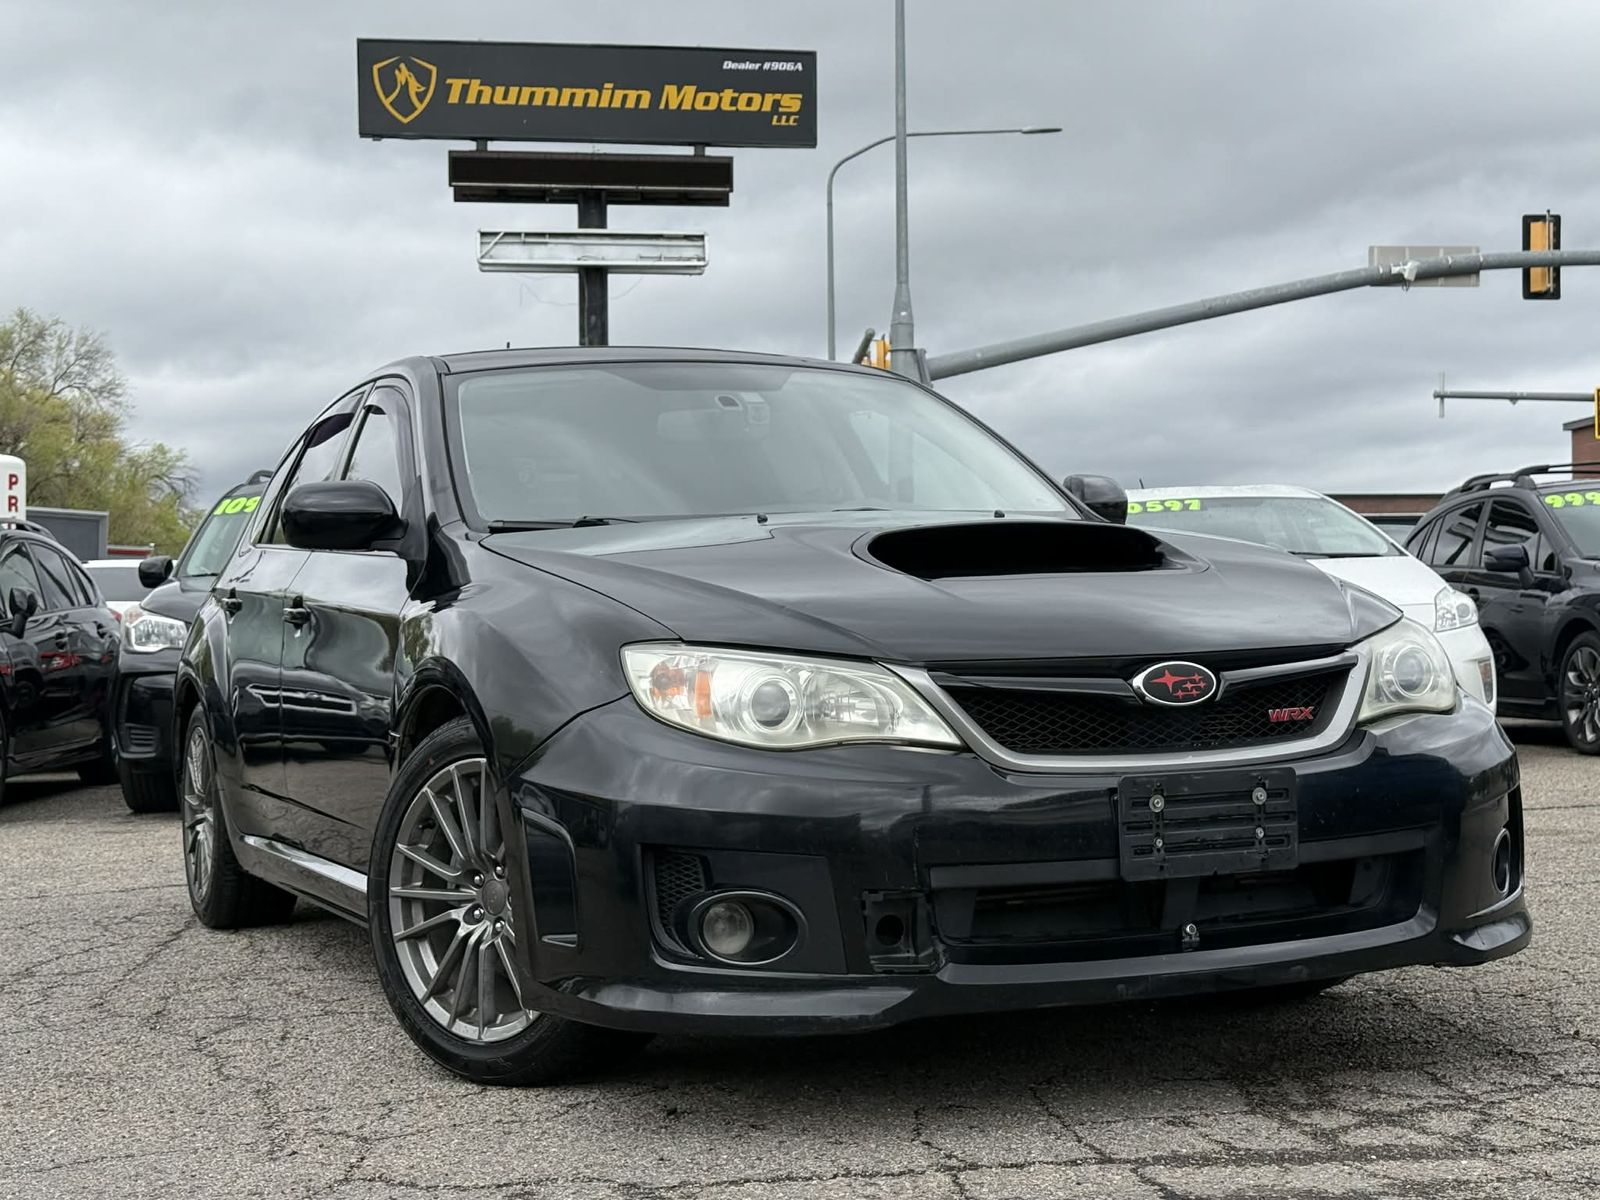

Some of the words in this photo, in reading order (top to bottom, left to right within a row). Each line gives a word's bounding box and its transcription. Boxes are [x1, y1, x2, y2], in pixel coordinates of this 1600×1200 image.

[722, 60, 761, 70] Dealer
[762, 61, 803, 71] #906A
[445, 78, 652, 109] Thummim
[658, 84, 802, 112] Motors
[771, 115, 799, 126] LLC
[1268, 706, 1314, 722] WRX
